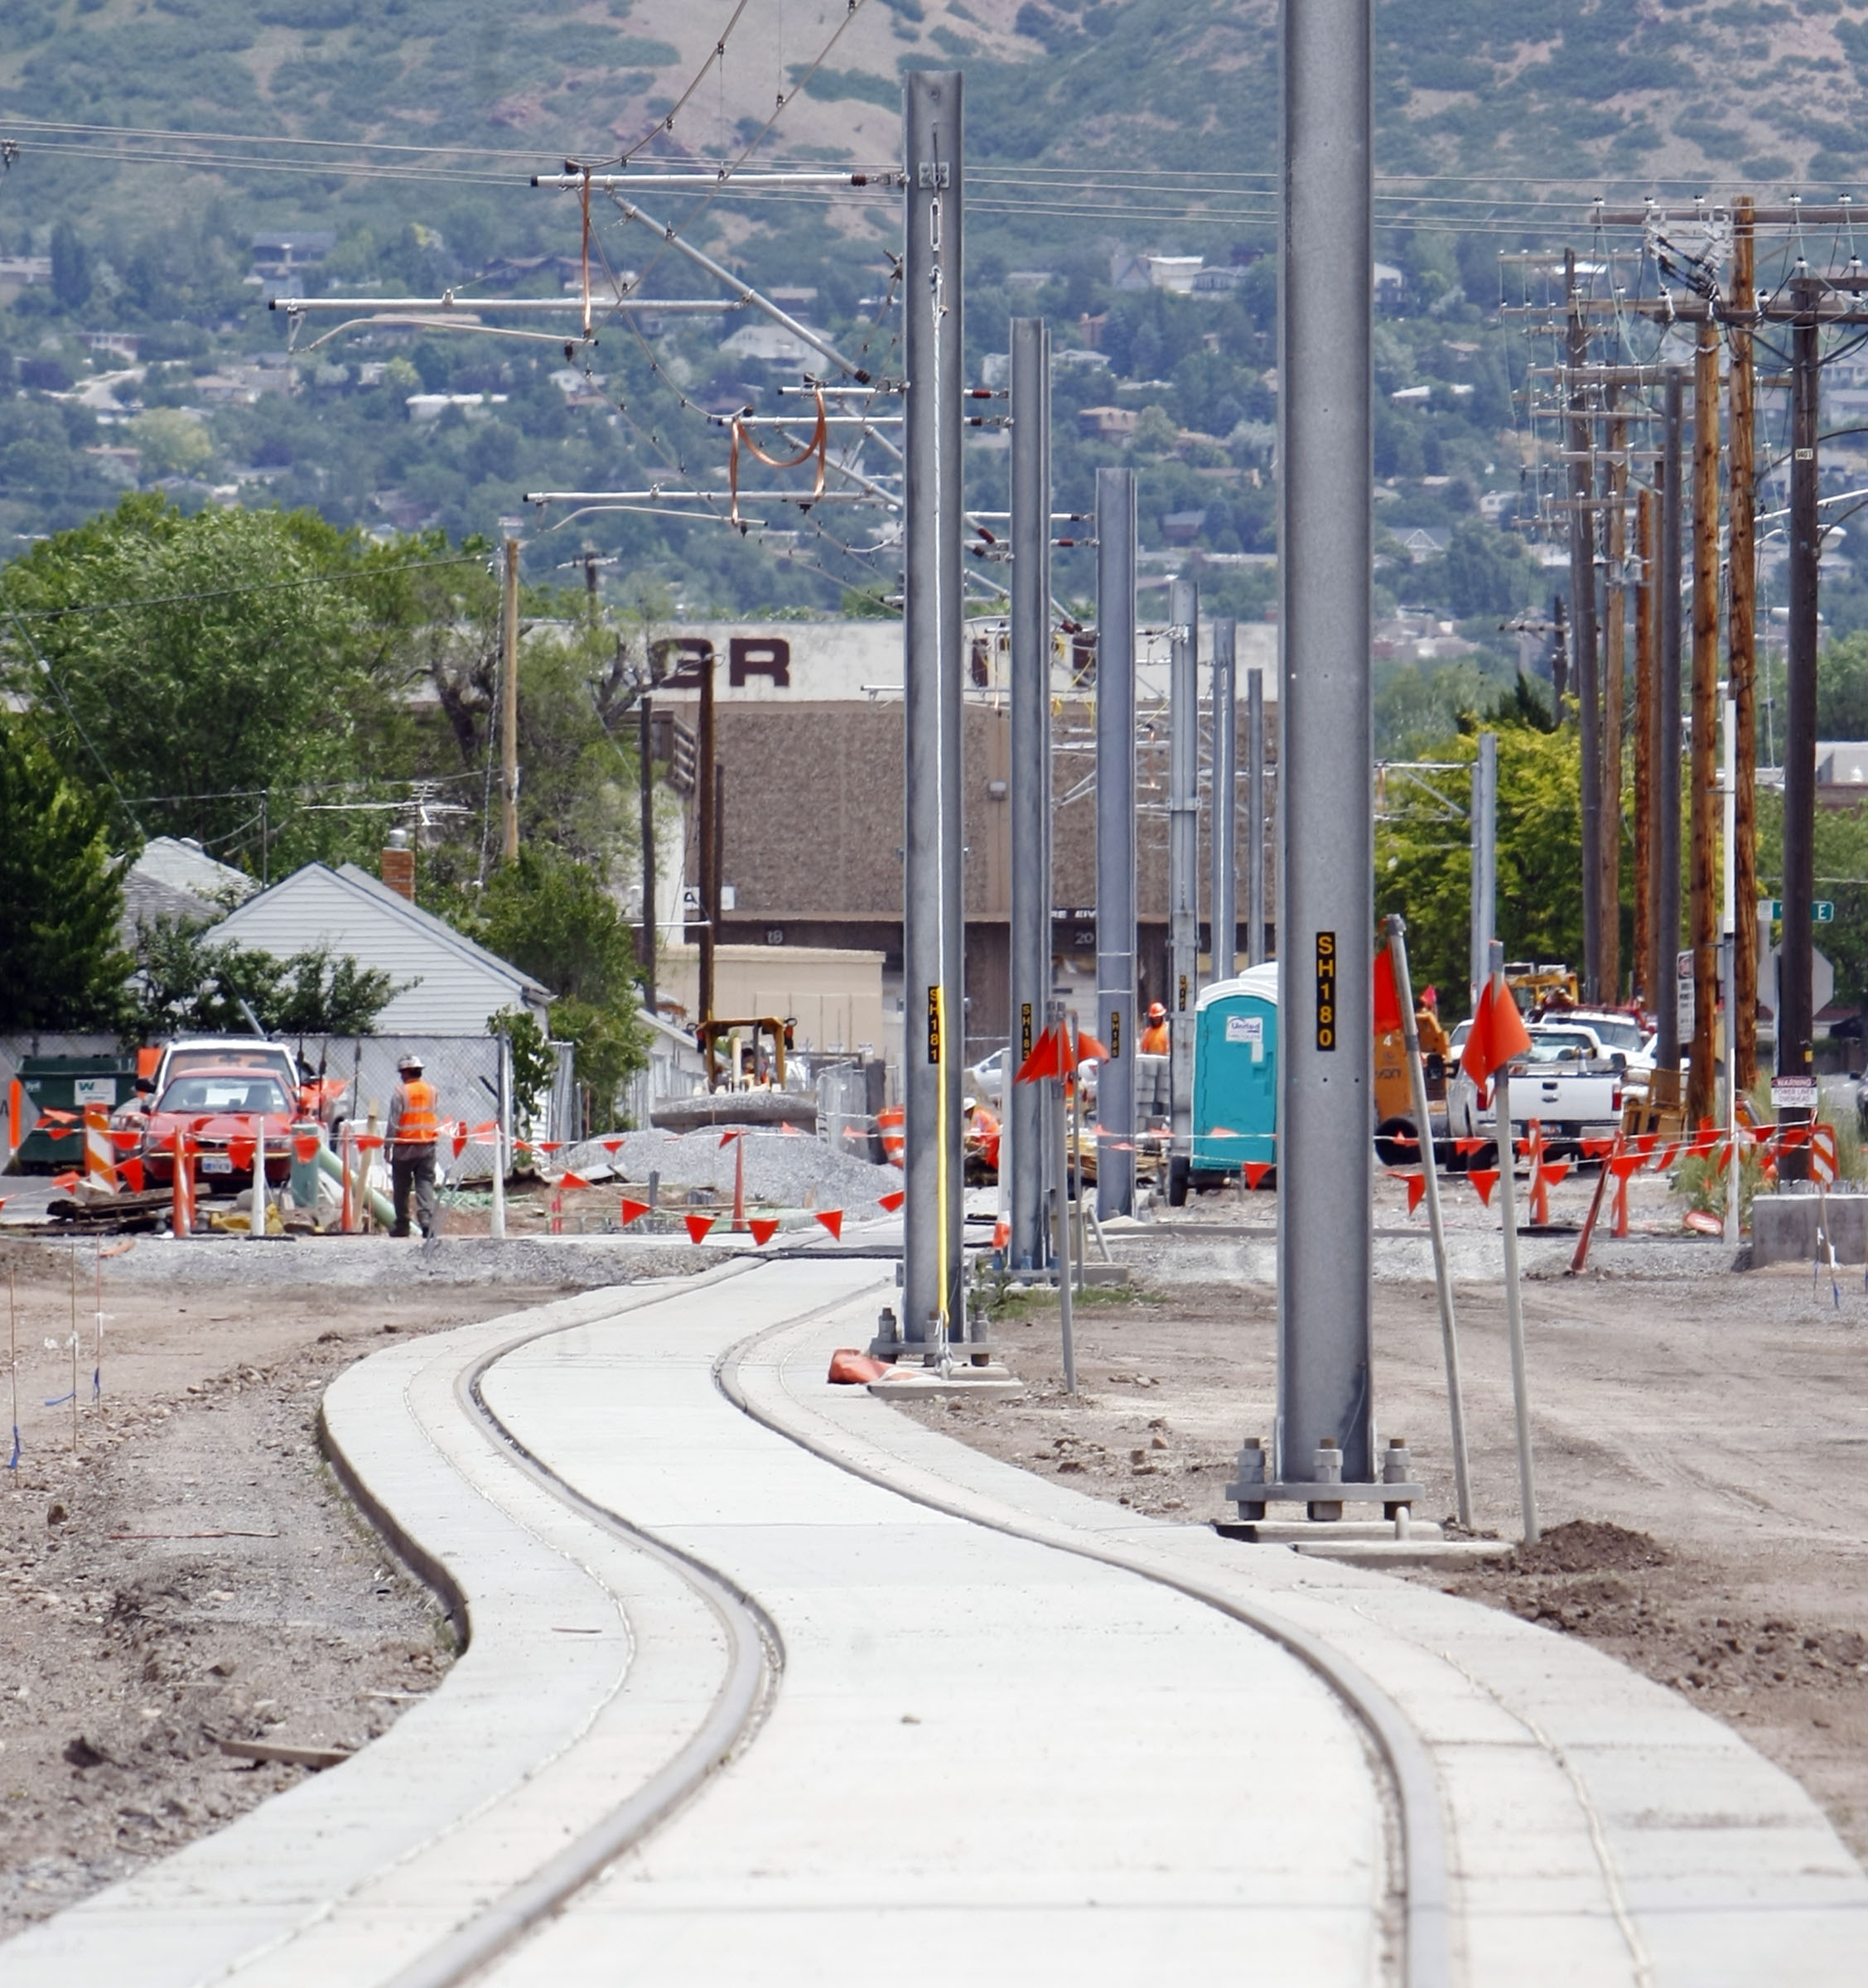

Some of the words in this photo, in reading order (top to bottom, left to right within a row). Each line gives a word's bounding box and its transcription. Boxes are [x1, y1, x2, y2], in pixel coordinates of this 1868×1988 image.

[1074, 932, 1095, 945] 20
[929, 989, 940, 1061] SH181
[1318, 936, 1334, 1046] SH180
